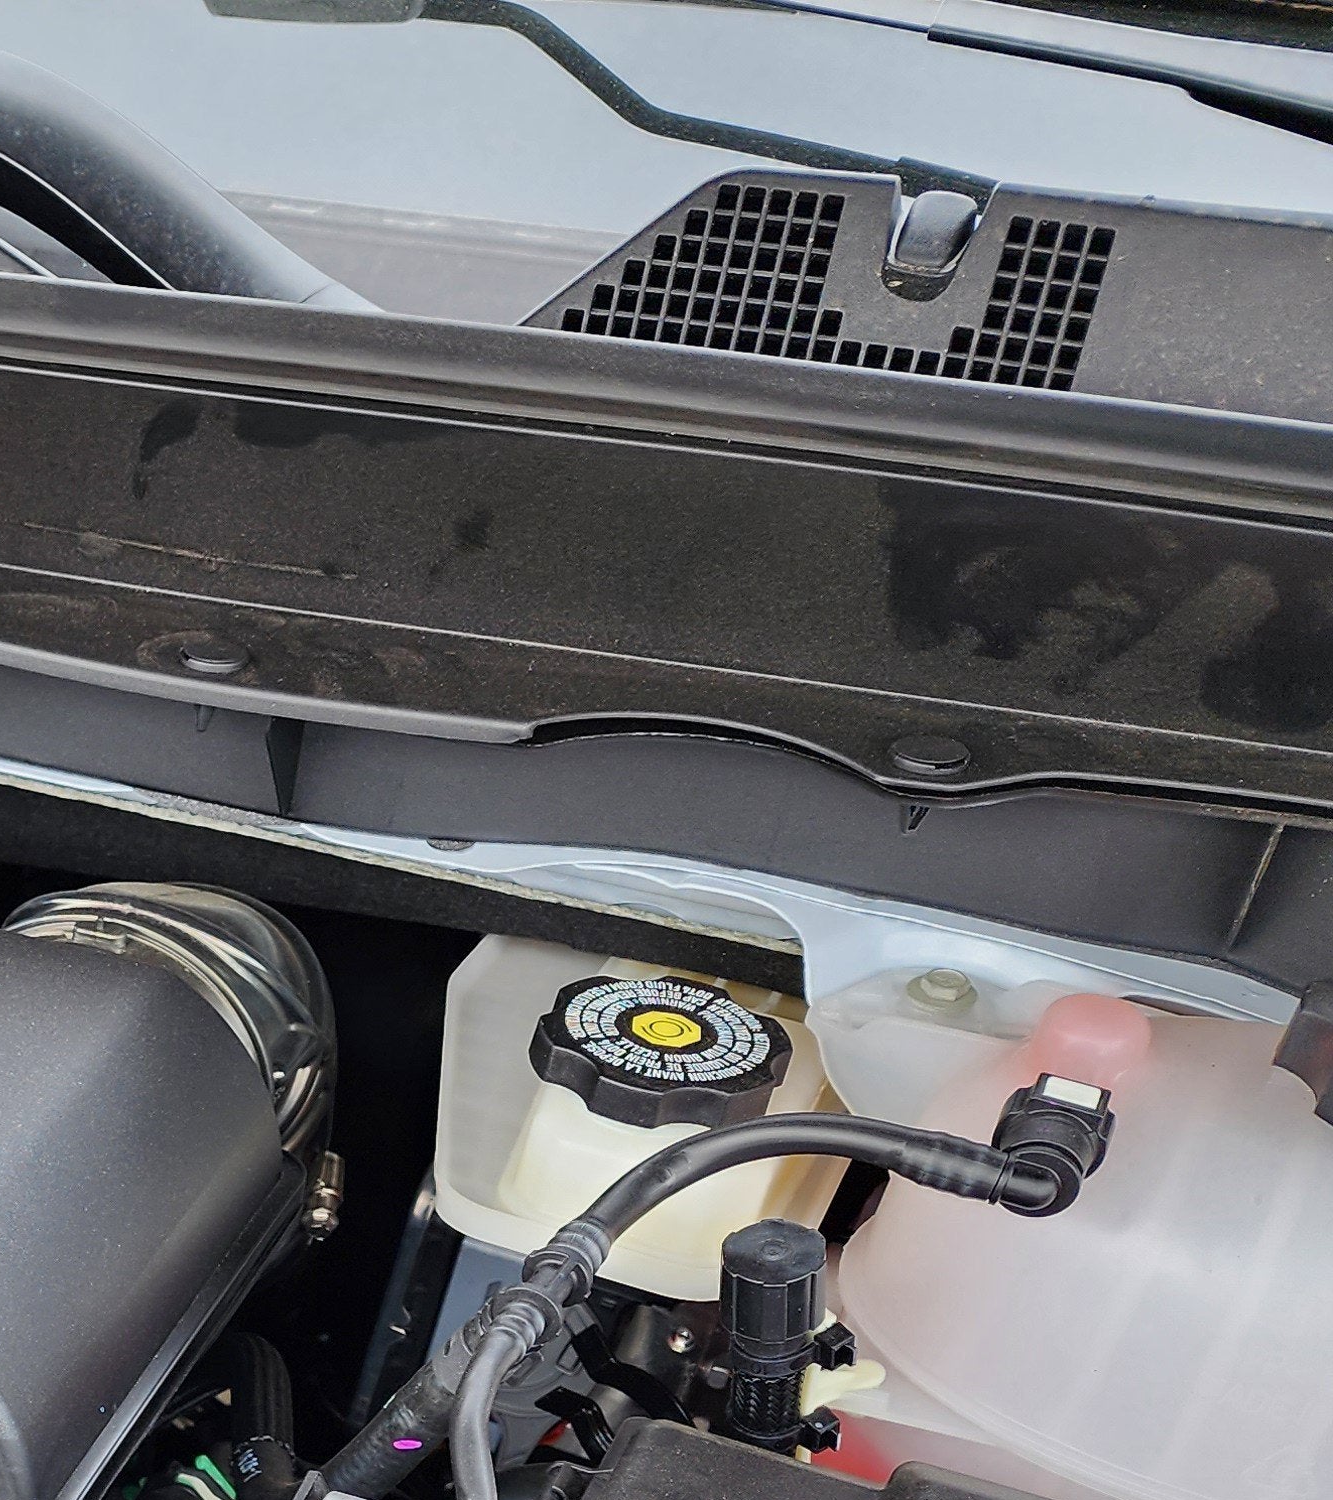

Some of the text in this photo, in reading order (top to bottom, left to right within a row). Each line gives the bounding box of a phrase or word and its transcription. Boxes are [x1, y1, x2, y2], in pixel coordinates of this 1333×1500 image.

[598, 983, 613, 993] A
[608, 979, 645, 991] FROM
[643, 979, 681, 992] FLUID
[633, 987, 682, 1000] BEFORE
[681, 994, 708, 1007] CAP
[623, 1052, 662, 1070] FREIN
[663, 1052, 704, 1064] BIDON
[624, 1061, 643, 1074] LA
[665, 1061, 683, 1073] DE
[735, 1059, 756, 1072] LE
[642, 1067, 685, 1082] AVANT
[686, 1064, 744, 1082] BOUCHON
